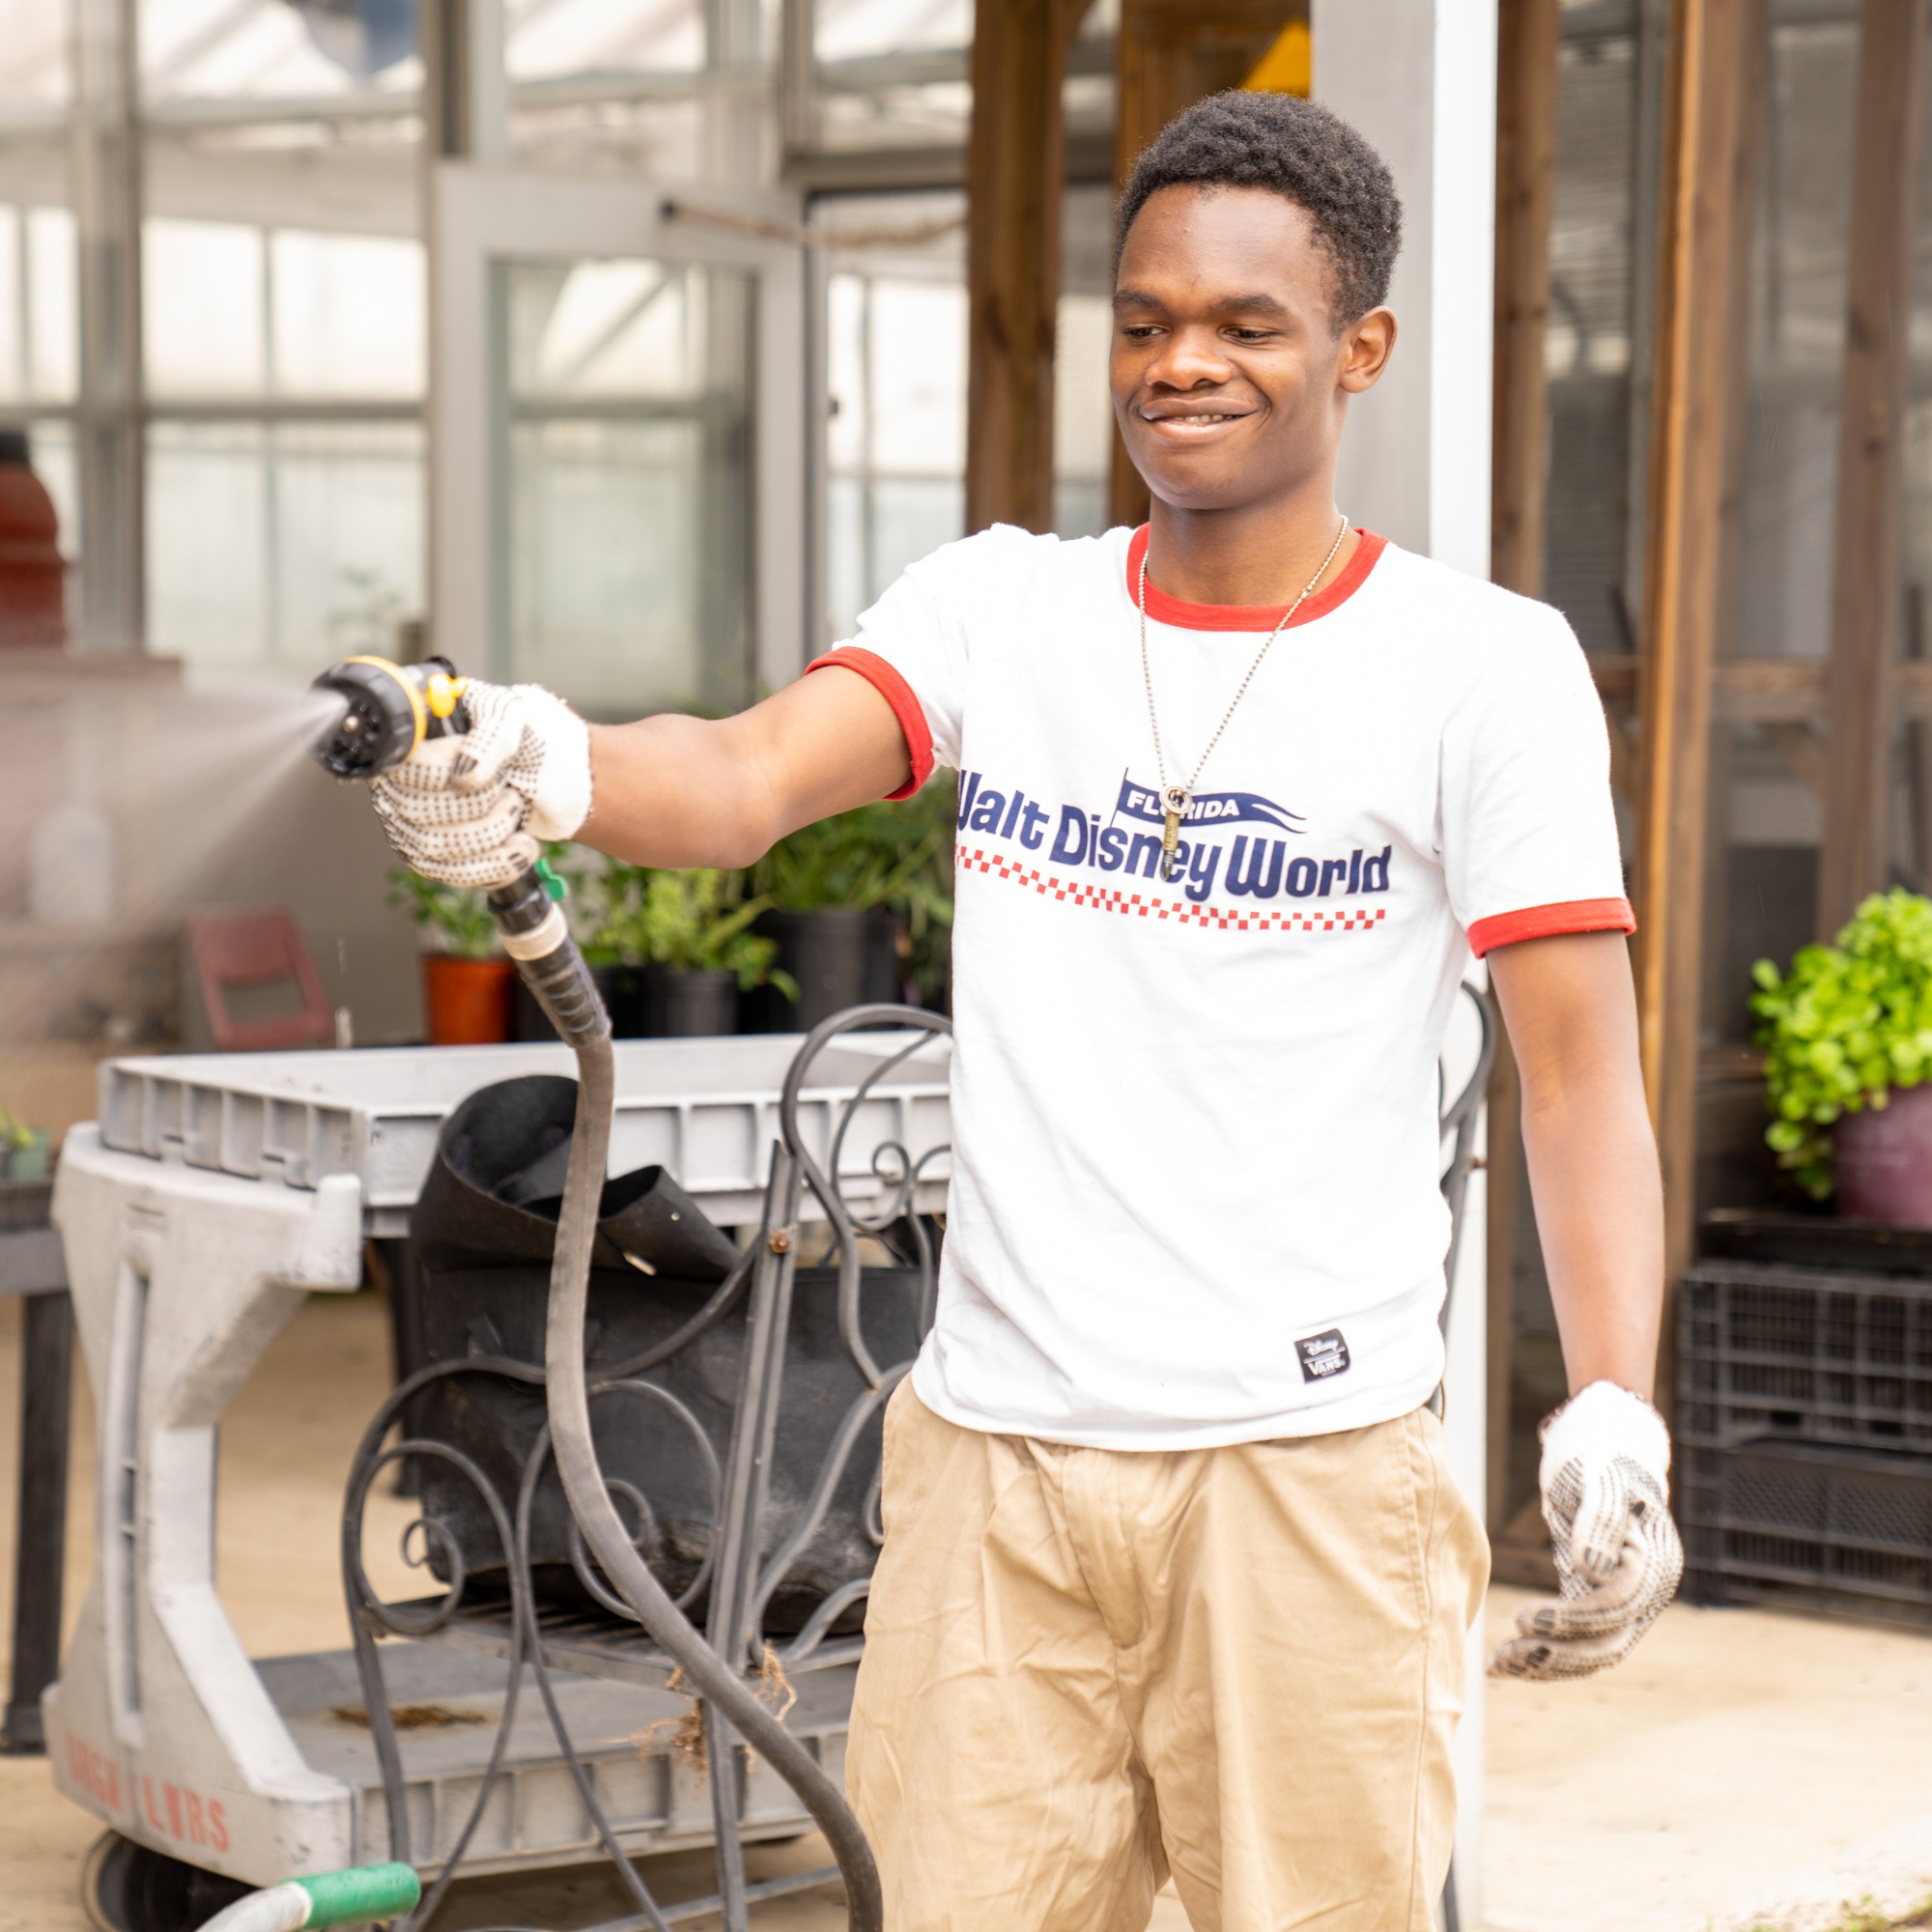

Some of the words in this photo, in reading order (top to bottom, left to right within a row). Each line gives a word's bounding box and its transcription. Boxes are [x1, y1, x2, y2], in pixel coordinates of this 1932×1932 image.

[1126, 789, 1240, 820] FLRIDA
[1049, 804, 1224, 902] Disney
[1224, 835, 1392, 899] World
[1307, 1353, 1342, 1376] VANS
